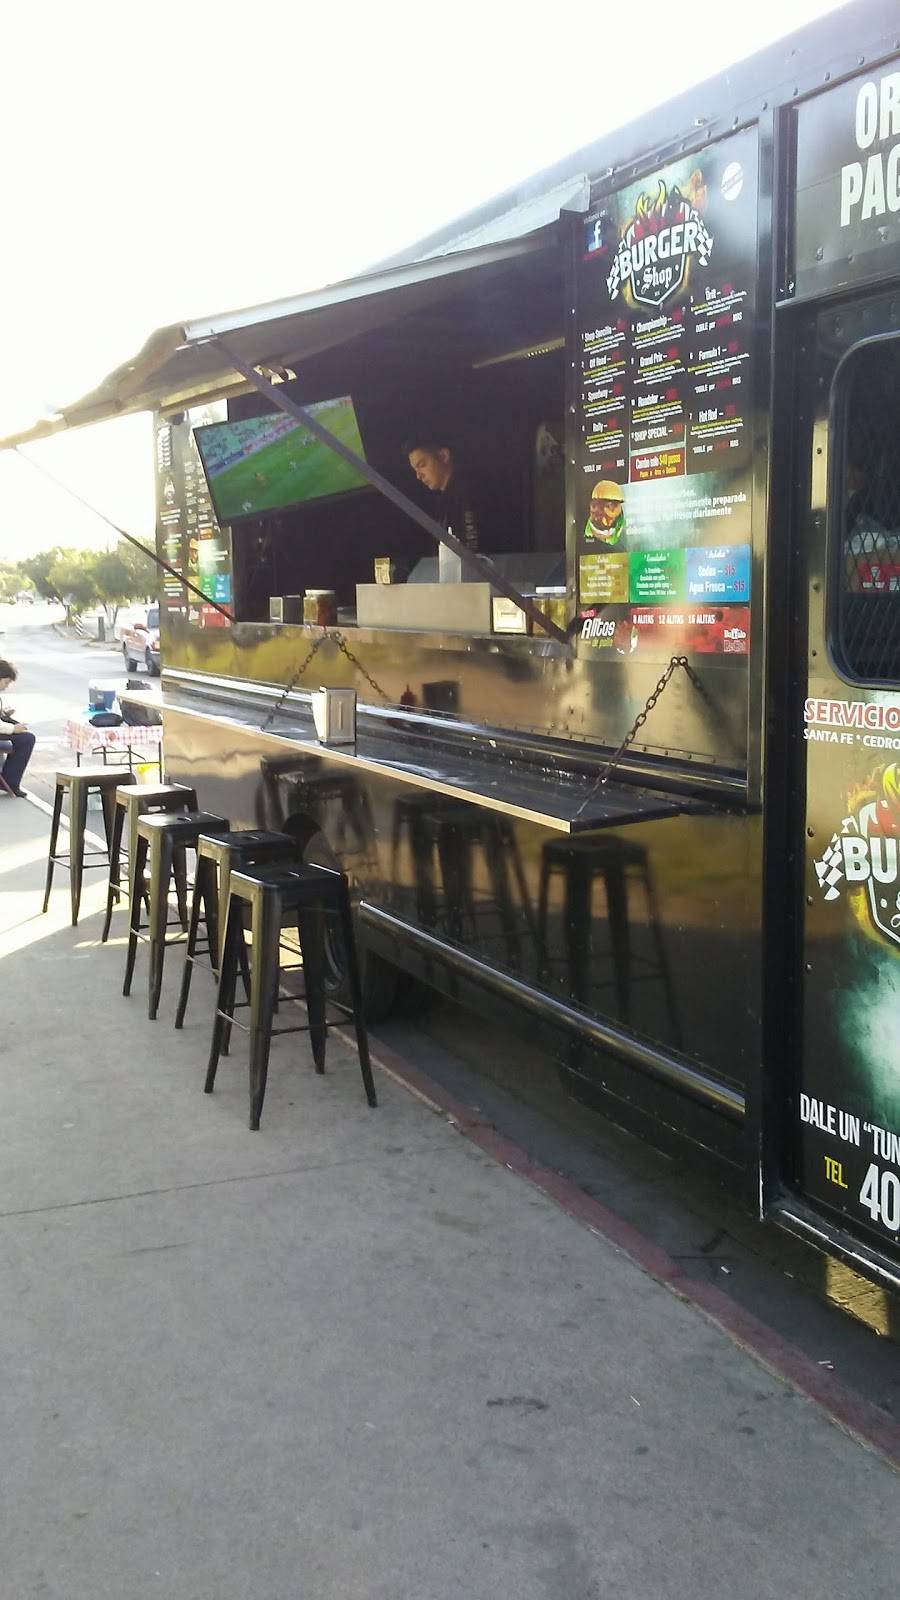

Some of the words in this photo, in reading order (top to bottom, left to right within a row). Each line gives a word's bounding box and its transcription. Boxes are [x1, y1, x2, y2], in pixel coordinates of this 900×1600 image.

[618, 220, 699, 281] BURGER
[640, 265, 673, 294] Shop
[647, 425, 669, 440] SPECIAL
[712, 491, 747, 507] preparada
[692, 506, 732, 519] diariamente
[689, 580, 704, 595] Agua
[637, 614, 655, 625] ALITAS
[658, 614, 666, 625] 12
[666, 614, 684, 625] ALITAS
[696, 613, 716, 625] ALITAS
[804, 697, 900, 732] SERVICIO
[803, 728, 839, 743] SANTA
[840, 733, 854, 745] FE
[863, 735, 900, 750] CEDRO
[800, 1092, 836, 1136] DALE
[839, 1110, 860, 1147] UN
[859, 1162, 900, 1232] 40
